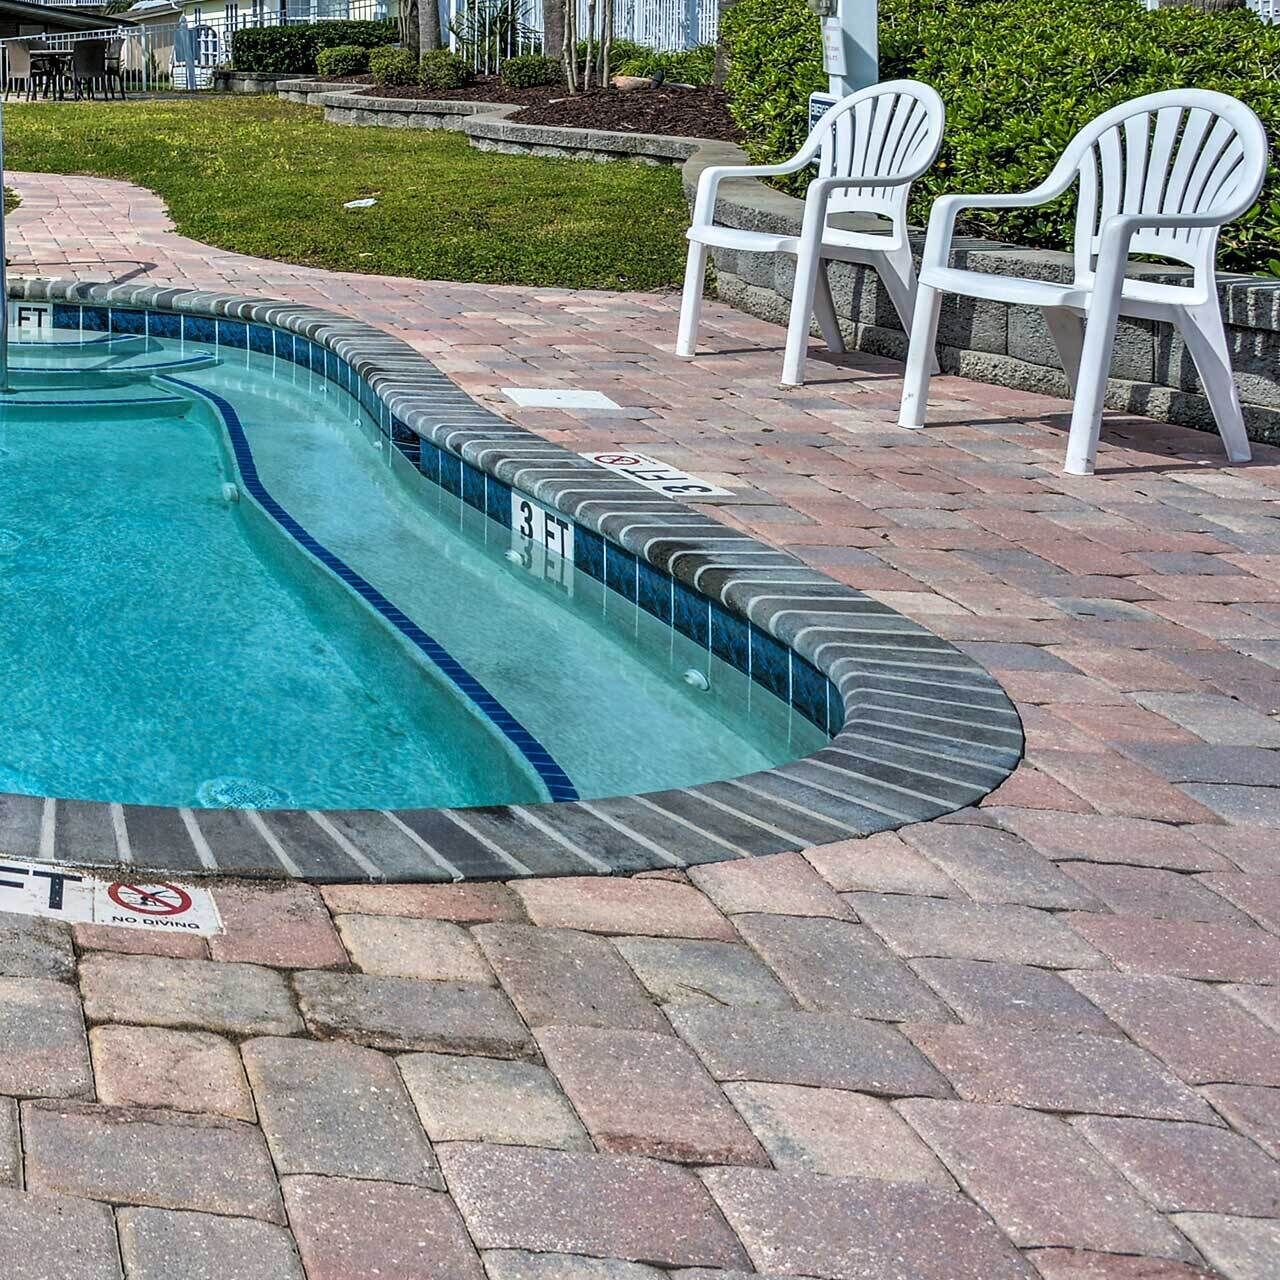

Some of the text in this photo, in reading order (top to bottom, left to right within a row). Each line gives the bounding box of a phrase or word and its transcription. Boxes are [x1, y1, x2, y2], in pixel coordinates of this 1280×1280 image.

[18, 306, 48, 327] FT
[619, 468, 713, 493] 3 FT
[520, 501, 569, 559] 3 FT
[112, 915, 200, 930] NO DIVING
